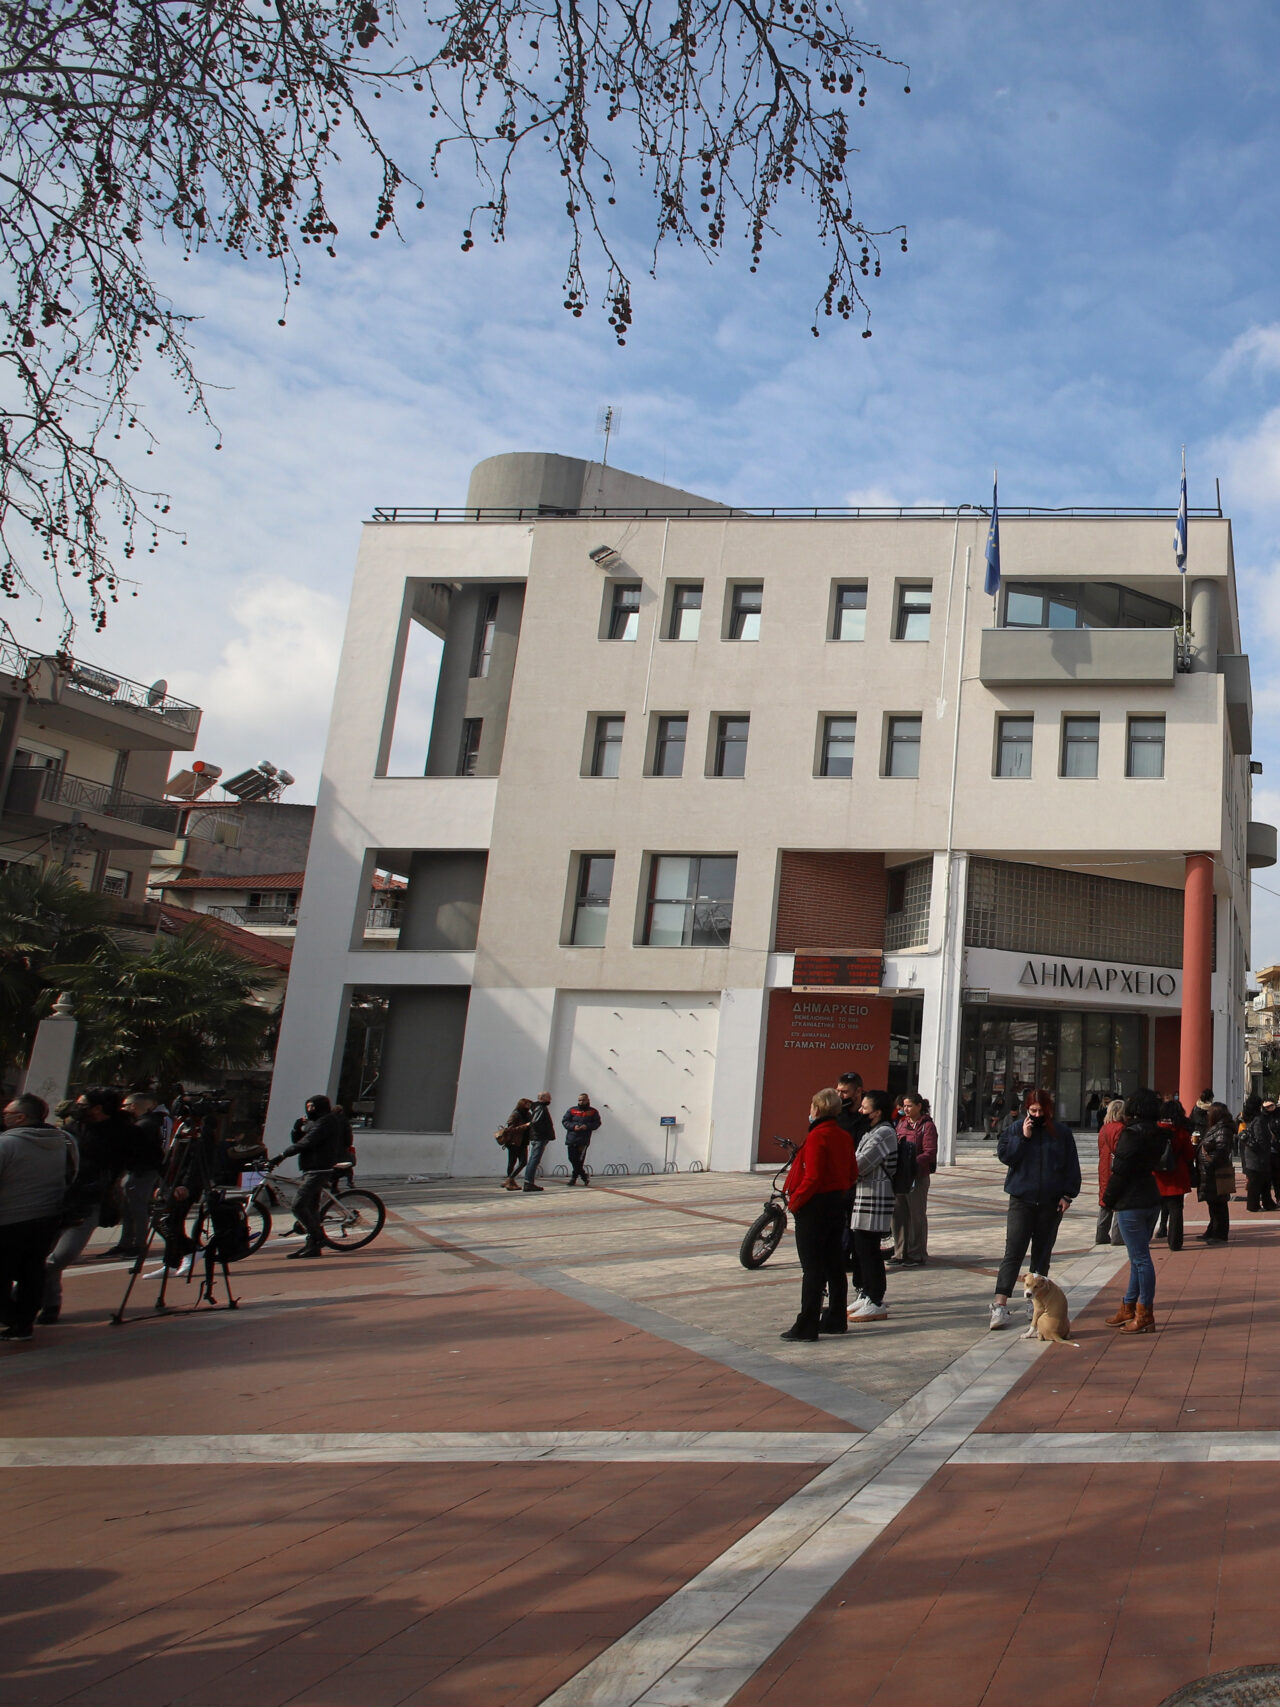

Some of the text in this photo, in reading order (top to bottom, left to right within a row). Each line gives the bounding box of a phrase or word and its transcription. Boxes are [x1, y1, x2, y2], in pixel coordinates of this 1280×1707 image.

[1018, 960, 1176, 997] ΔΗΜΑΡΧΕΙΟ
[792, 1002, 869, 1016] ΔΗΜΑΡΧΕΙΟ
[784, 1040, 875, 1051] ΣΤΑΜΑΤΗ ΔΙΟΝΥΣΙΟΥ
